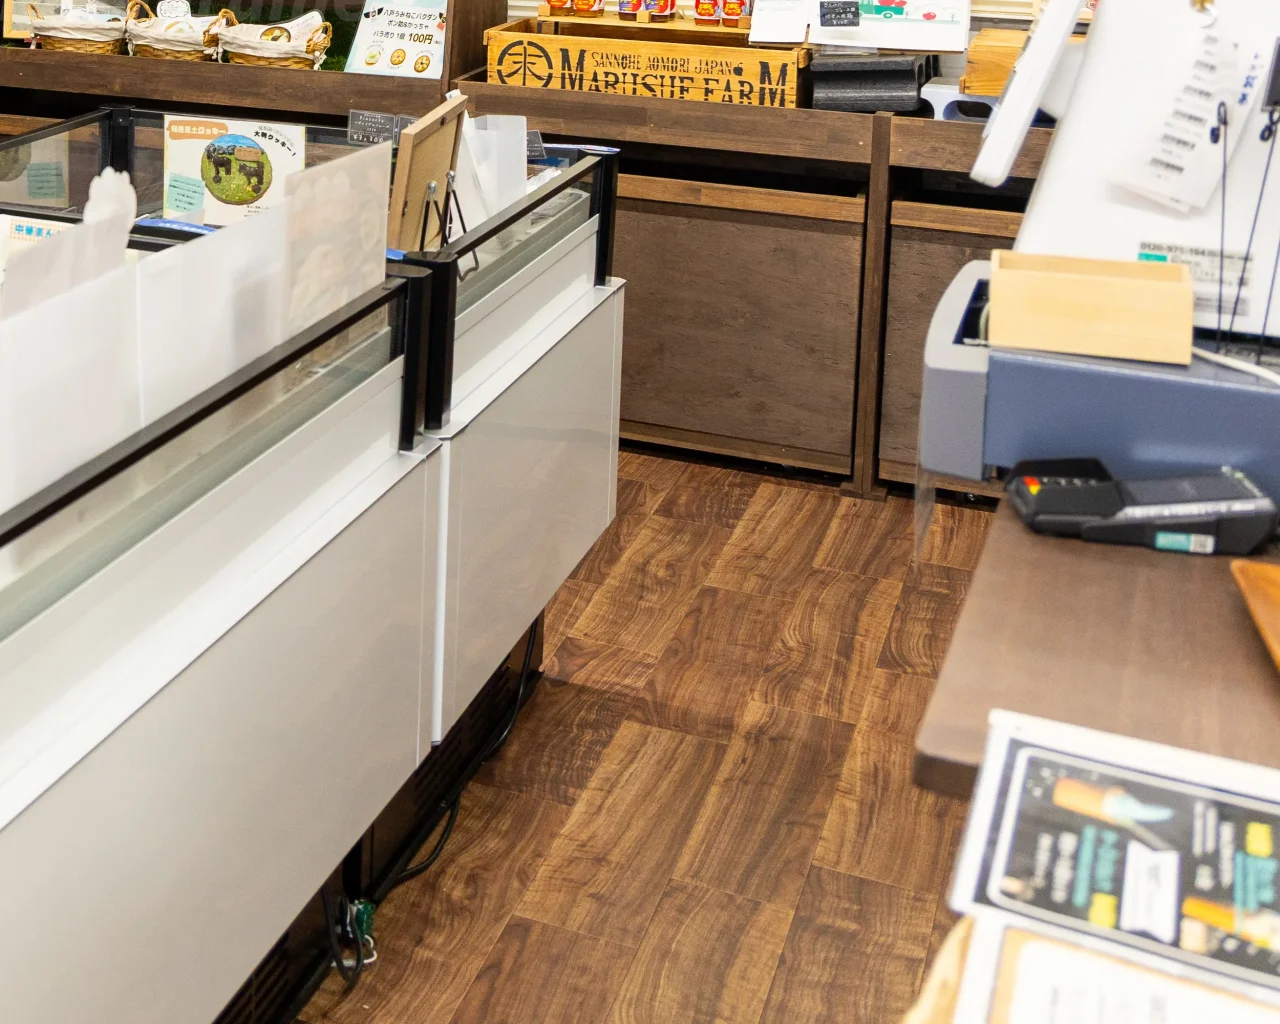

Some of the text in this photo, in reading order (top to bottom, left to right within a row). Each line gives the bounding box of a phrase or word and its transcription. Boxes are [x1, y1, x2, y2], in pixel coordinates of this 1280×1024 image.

[383, 9, 438, 21] 八戸うみねこバクダン
[373, 30, 395, 39] バラ売り
[408, 32, 434, 45] 100円
[590, 50, 733, 76] SANNOHE AOMORI JAPAN
[703, 61, 790, 108] FARM
